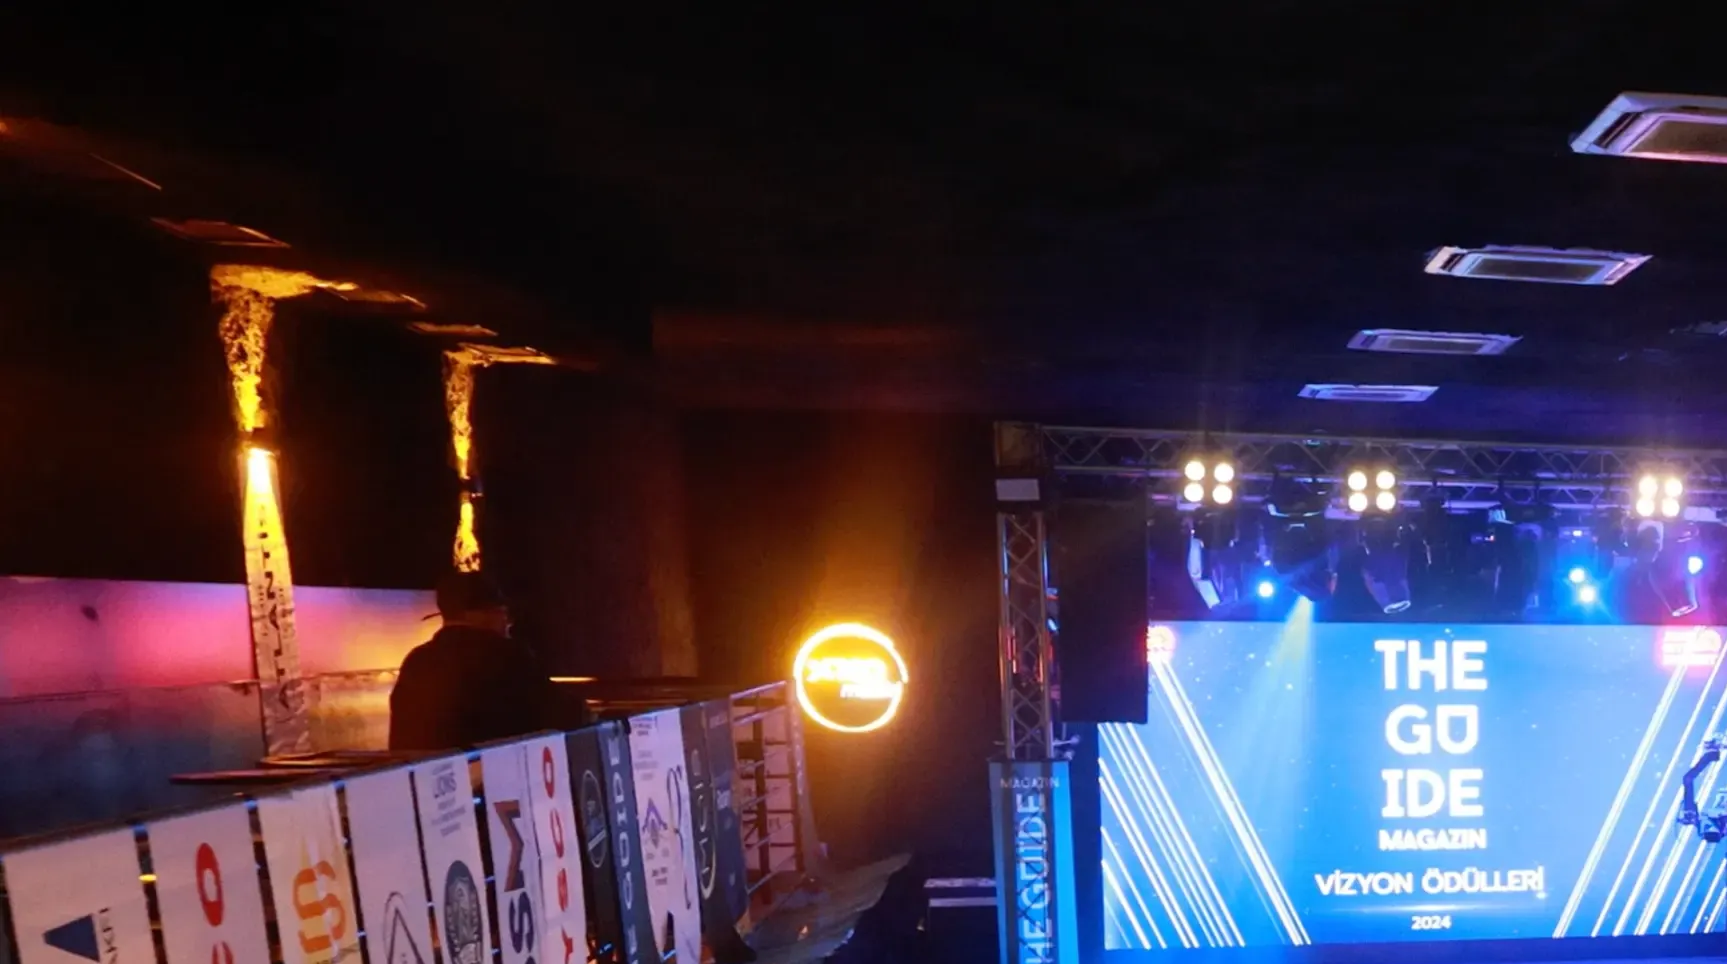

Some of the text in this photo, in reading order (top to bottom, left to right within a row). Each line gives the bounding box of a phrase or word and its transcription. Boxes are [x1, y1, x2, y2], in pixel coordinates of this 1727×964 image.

[1374, 640, 1487, 691] THE
[1381, 769, 1484, 817] IDE
[1379, 829, 1486, 850] MAGAZIN
[1314, 866, 1544, 895] VİZYON ÖDÜLLERİ
[1411, 916, 1451, 930] 2024
